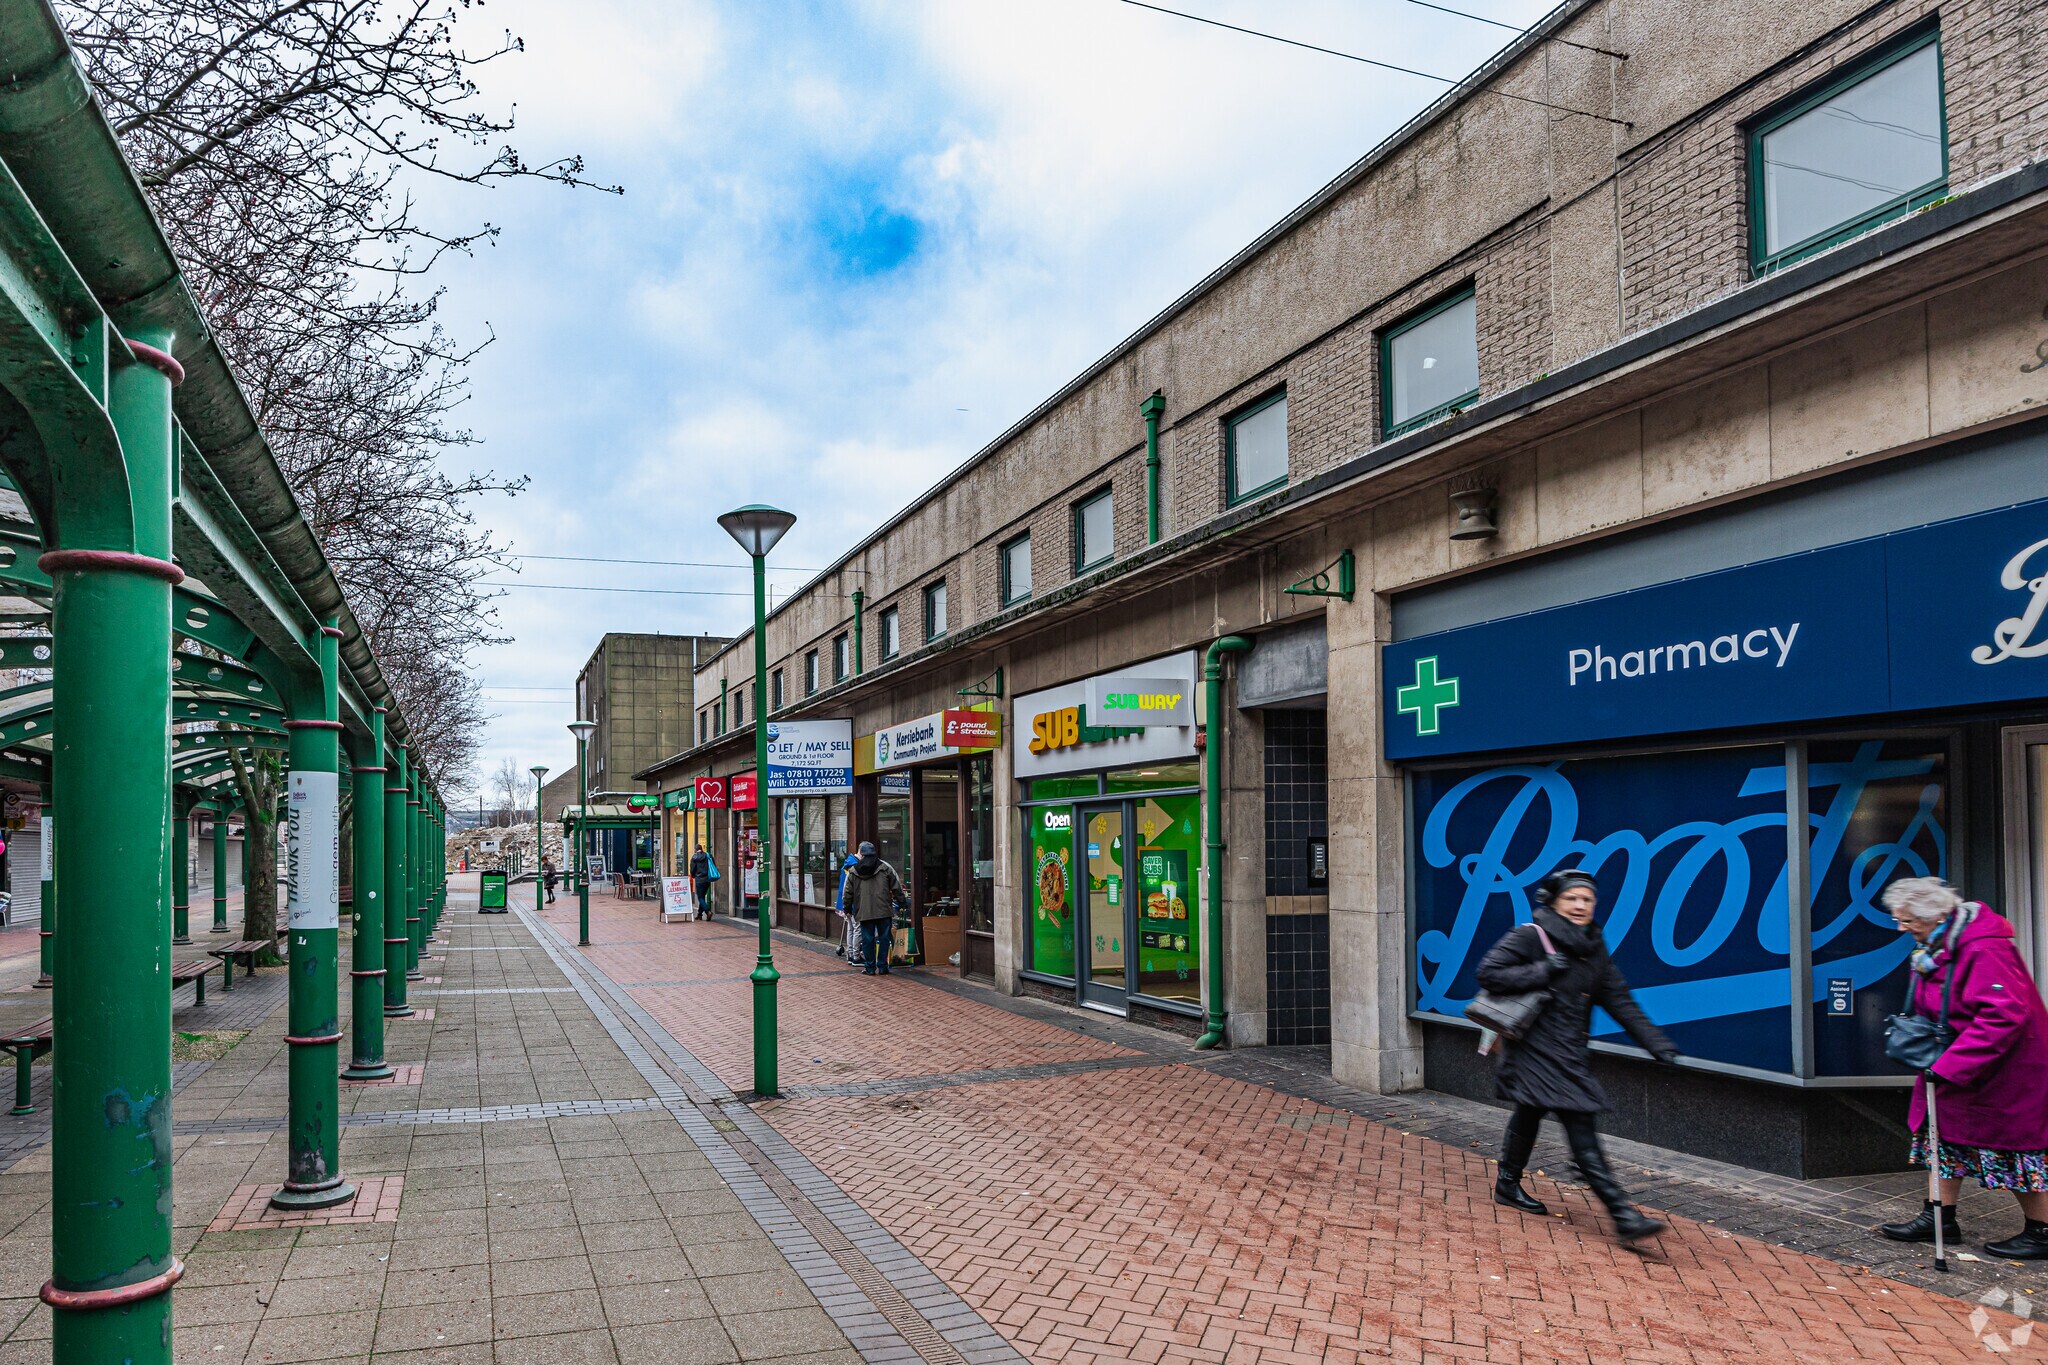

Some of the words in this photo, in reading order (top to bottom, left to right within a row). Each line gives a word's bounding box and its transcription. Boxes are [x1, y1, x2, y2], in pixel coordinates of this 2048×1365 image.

[1568, 622, 1801, 686] Pharmacy
[1103, 693, 1182, 710] SUBWAY
[896, 723, 934, 747] Kersiebank
[960, 728, 998, 736] stretcher
[767, 743, 776, 753] O
[779, 743, 794, 753] LET
[797, 742, 802, 754] /
[805, 742, 827, 752] MAY
[830, 741, 851, 751] SELL
[893, 747, 918, 760] Community
[920, 742, 937, 755] Project
[767, 779, 787, 787] Will:
[789, 778, 814, 787] 07581
[816, 777, 847, 786] 396092
[769, 771, 785, 779] Jas:
[787, 770, 812, 778] 07810
[814, 768, 845, 777] 717229
[289, 808, 300, 842] YOU
[303, 808, 313, 835] LOCAL
[1045, 811, 1070, 830] Open
[302, 839, 312, 884] SHOPPING
[1143, 856, 1162, 865] SAVER
[1143, 864, 1162, 874] SUBS
[288, 847, 299, 902] THANK
[302, 887, 311, 904] FOR
[1416, 741, 1946, 1034] Boots
